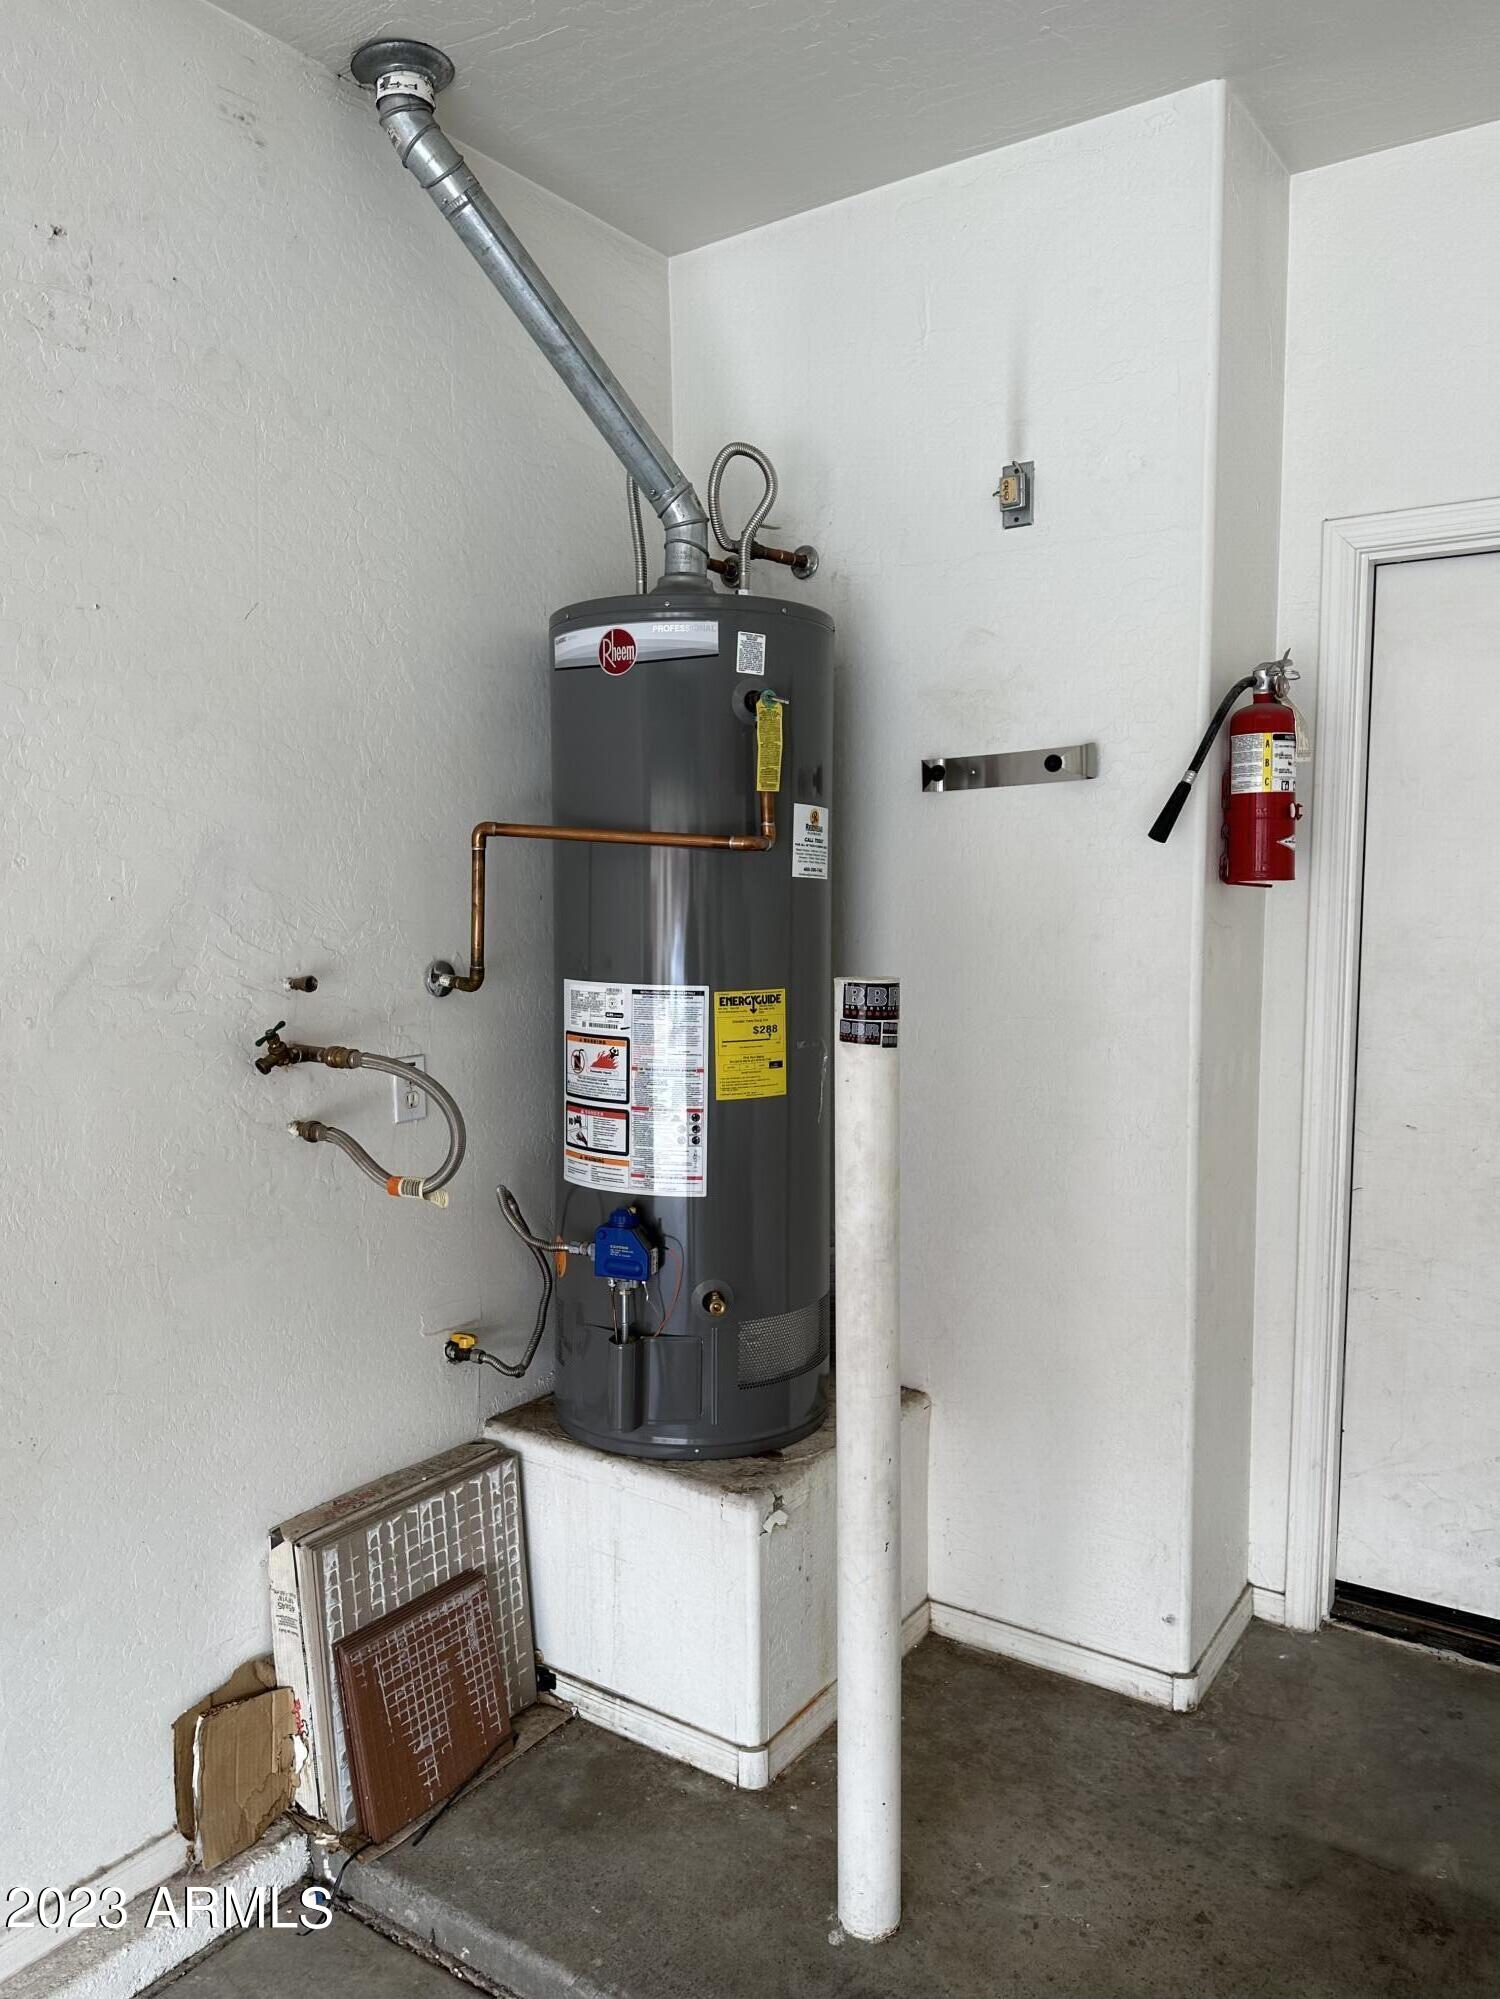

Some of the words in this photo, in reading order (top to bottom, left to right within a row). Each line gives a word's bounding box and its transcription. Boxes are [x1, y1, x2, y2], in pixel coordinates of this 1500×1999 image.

[602, 629, 636, 668] Rheem
[1265, 739, 1270, 748] A
[1265, 758, 1270, 767] B
[1264, 777, 1270, 786] C
